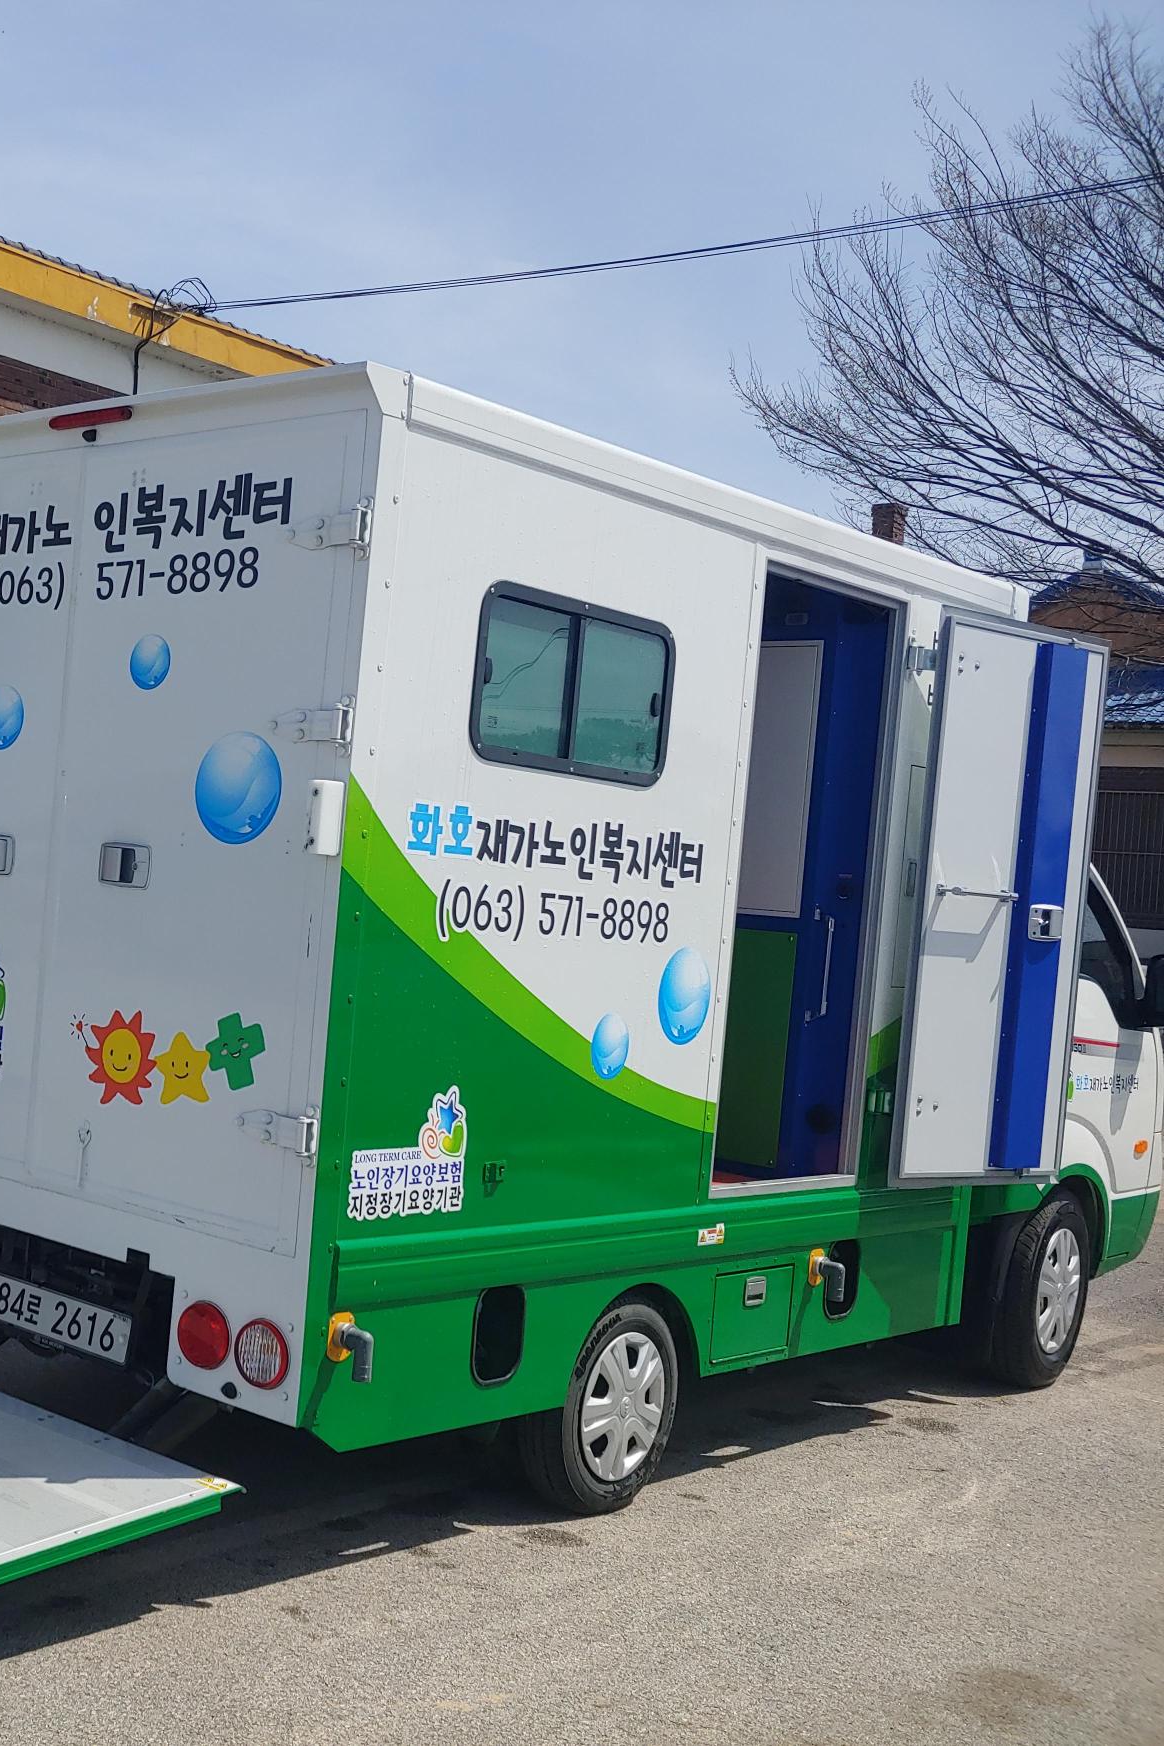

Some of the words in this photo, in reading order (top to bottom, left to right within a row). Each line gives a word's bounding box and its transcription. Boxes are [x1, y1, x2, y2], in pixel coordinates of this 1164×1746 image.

[93, 472, 293, 554] 인복지센터
[95, 546, 260, 601] 571-8898
[407, 802, 704, 889] 화호재가노인복지센터
[437, 877, 525, 942] (063)
[538, 891, 670, 944] 571-8898
[1075, 1073, 1139, 1095] 화호재가노인복지센터
[351, 1161, 462, 1191] 노인장기요양보험
[354, 1152, 377, 1164] LONG
[377, 1151, 401, 1163] TERM
[401, 1150, 422, 1161] CARE
[349, 1185, 462, 1217] 지정장기요양기관
[50, 1301, 115, 1352] 2616
